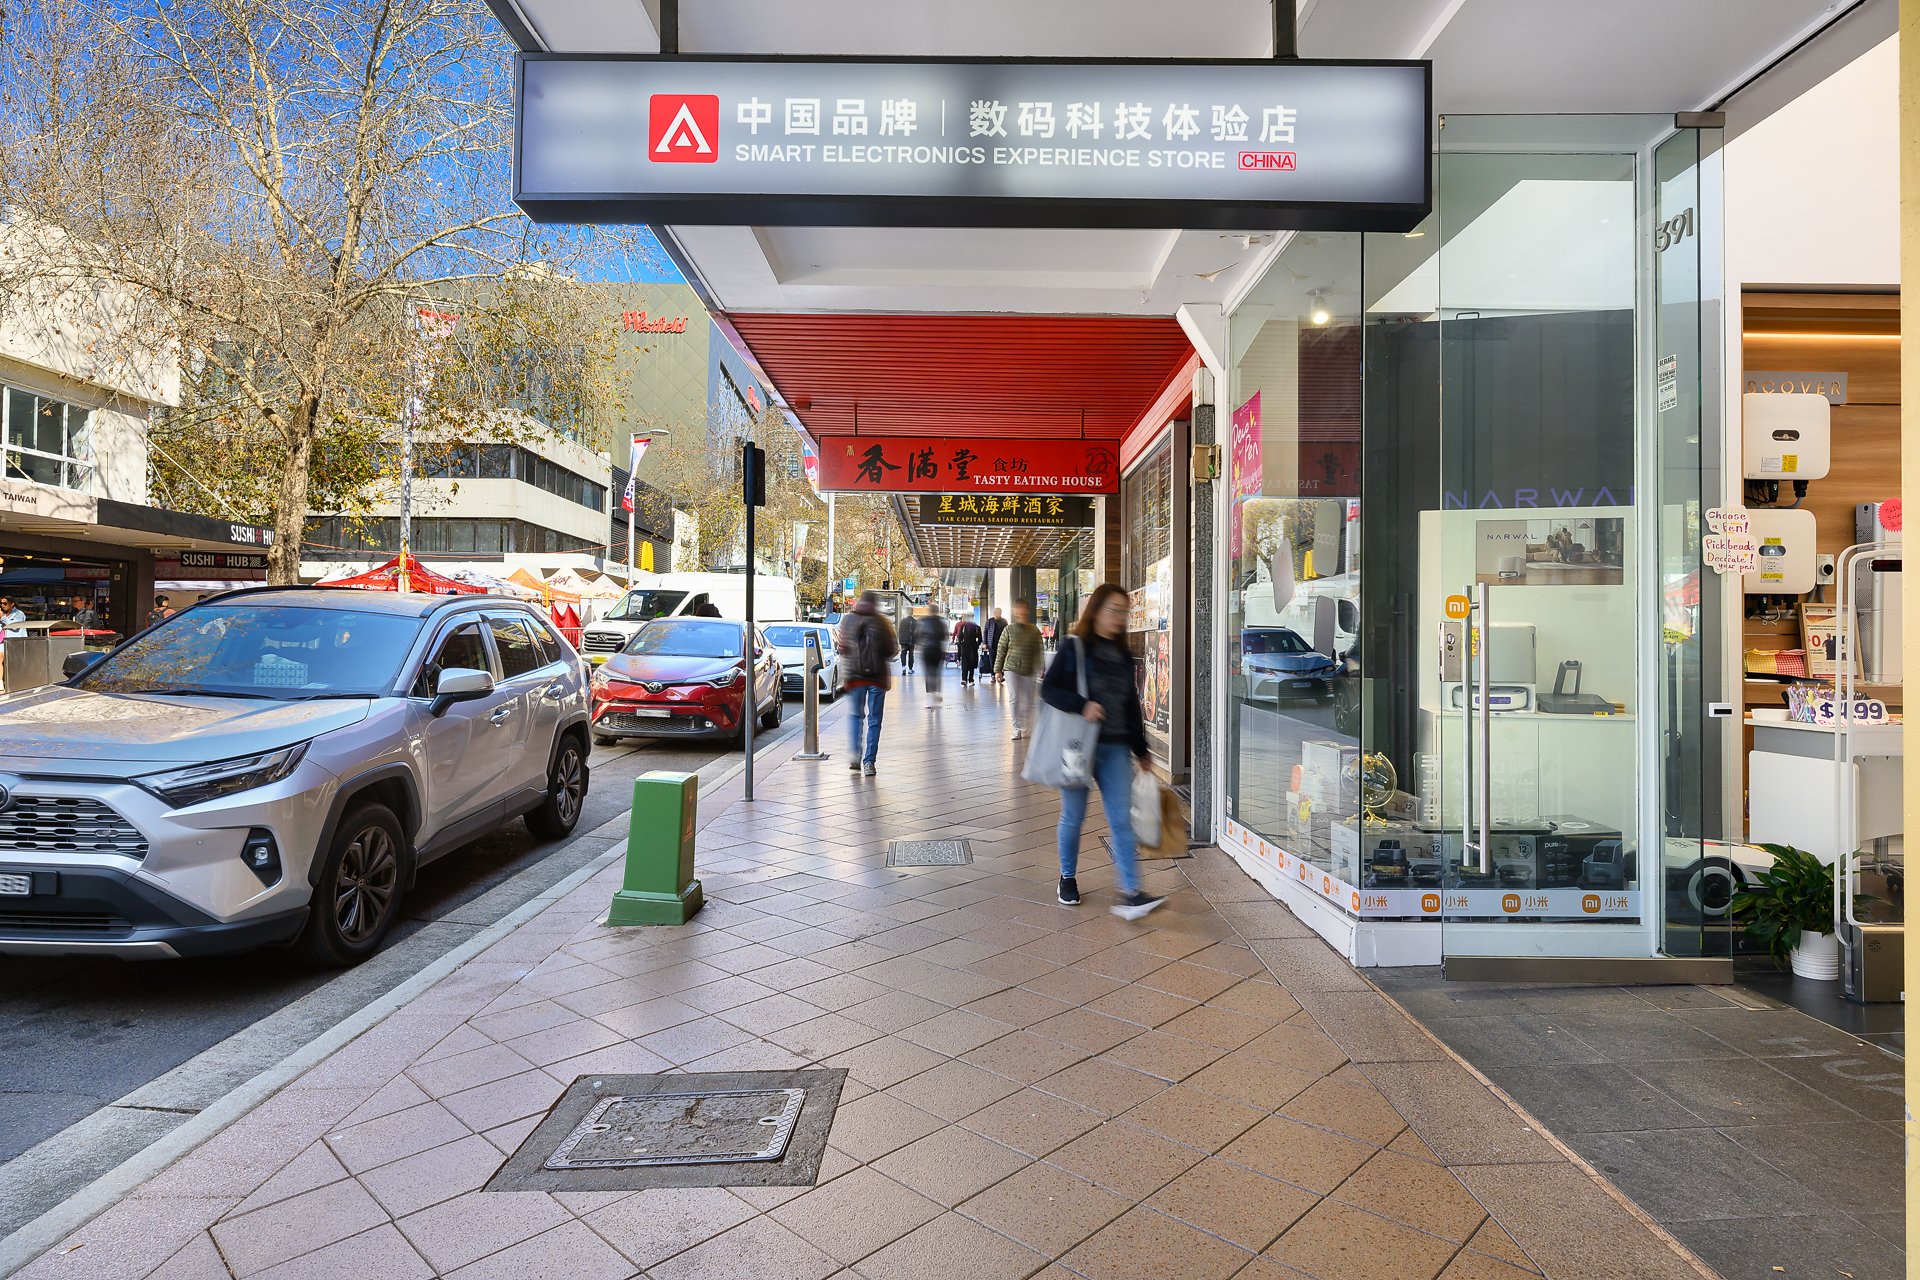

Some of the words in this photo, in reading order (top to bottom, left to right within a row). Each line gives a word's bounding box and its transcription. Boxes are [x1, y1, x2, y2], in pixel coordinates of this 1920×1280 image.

[737, 96, 918, 136] 中国品牌
[970, 100, 1297, 144] 数码科技体验店
[735, 144, 816, 162] SMART
[823, 145, 986, 165] ELECTRONICS
[993, 147, 1140, 168] EXPERIENCE
[1148, 150, 1225, 169] STORE
[1241, 154, 1294, 169] CHINA
[1655, 207, 1694, 253] 391
[623, 310, 688, 333] Westfield
[974, 475, 1011, 485] TASTY
[1014, 475, 1059, 486] EATING
[1061, 476, 1103, 487] HOUSE
[3, 492, 37, 505] TAIWAN
[938, 495, 1065, 515] 星城海鮮酒家
[1708, 511, 1747, 520] Choose
[230, 524, 256, 544] SUSHI
[263, 529, 275, 546] HU
[1705, 538, 1726, 550] Pick
[1727, 538, 1756, 551] beads
[182, 553, 216, 567] SUSHI
[226, 555, 249, 568] HUB
[806, 639, 814, 648] P
[1364, 895, 1388, 907] 小米
[1445, 895, 1469, 907] 小米
[1525, 895, 1549, 907] 小米
[1604, 896, 1629, 908] 小米
